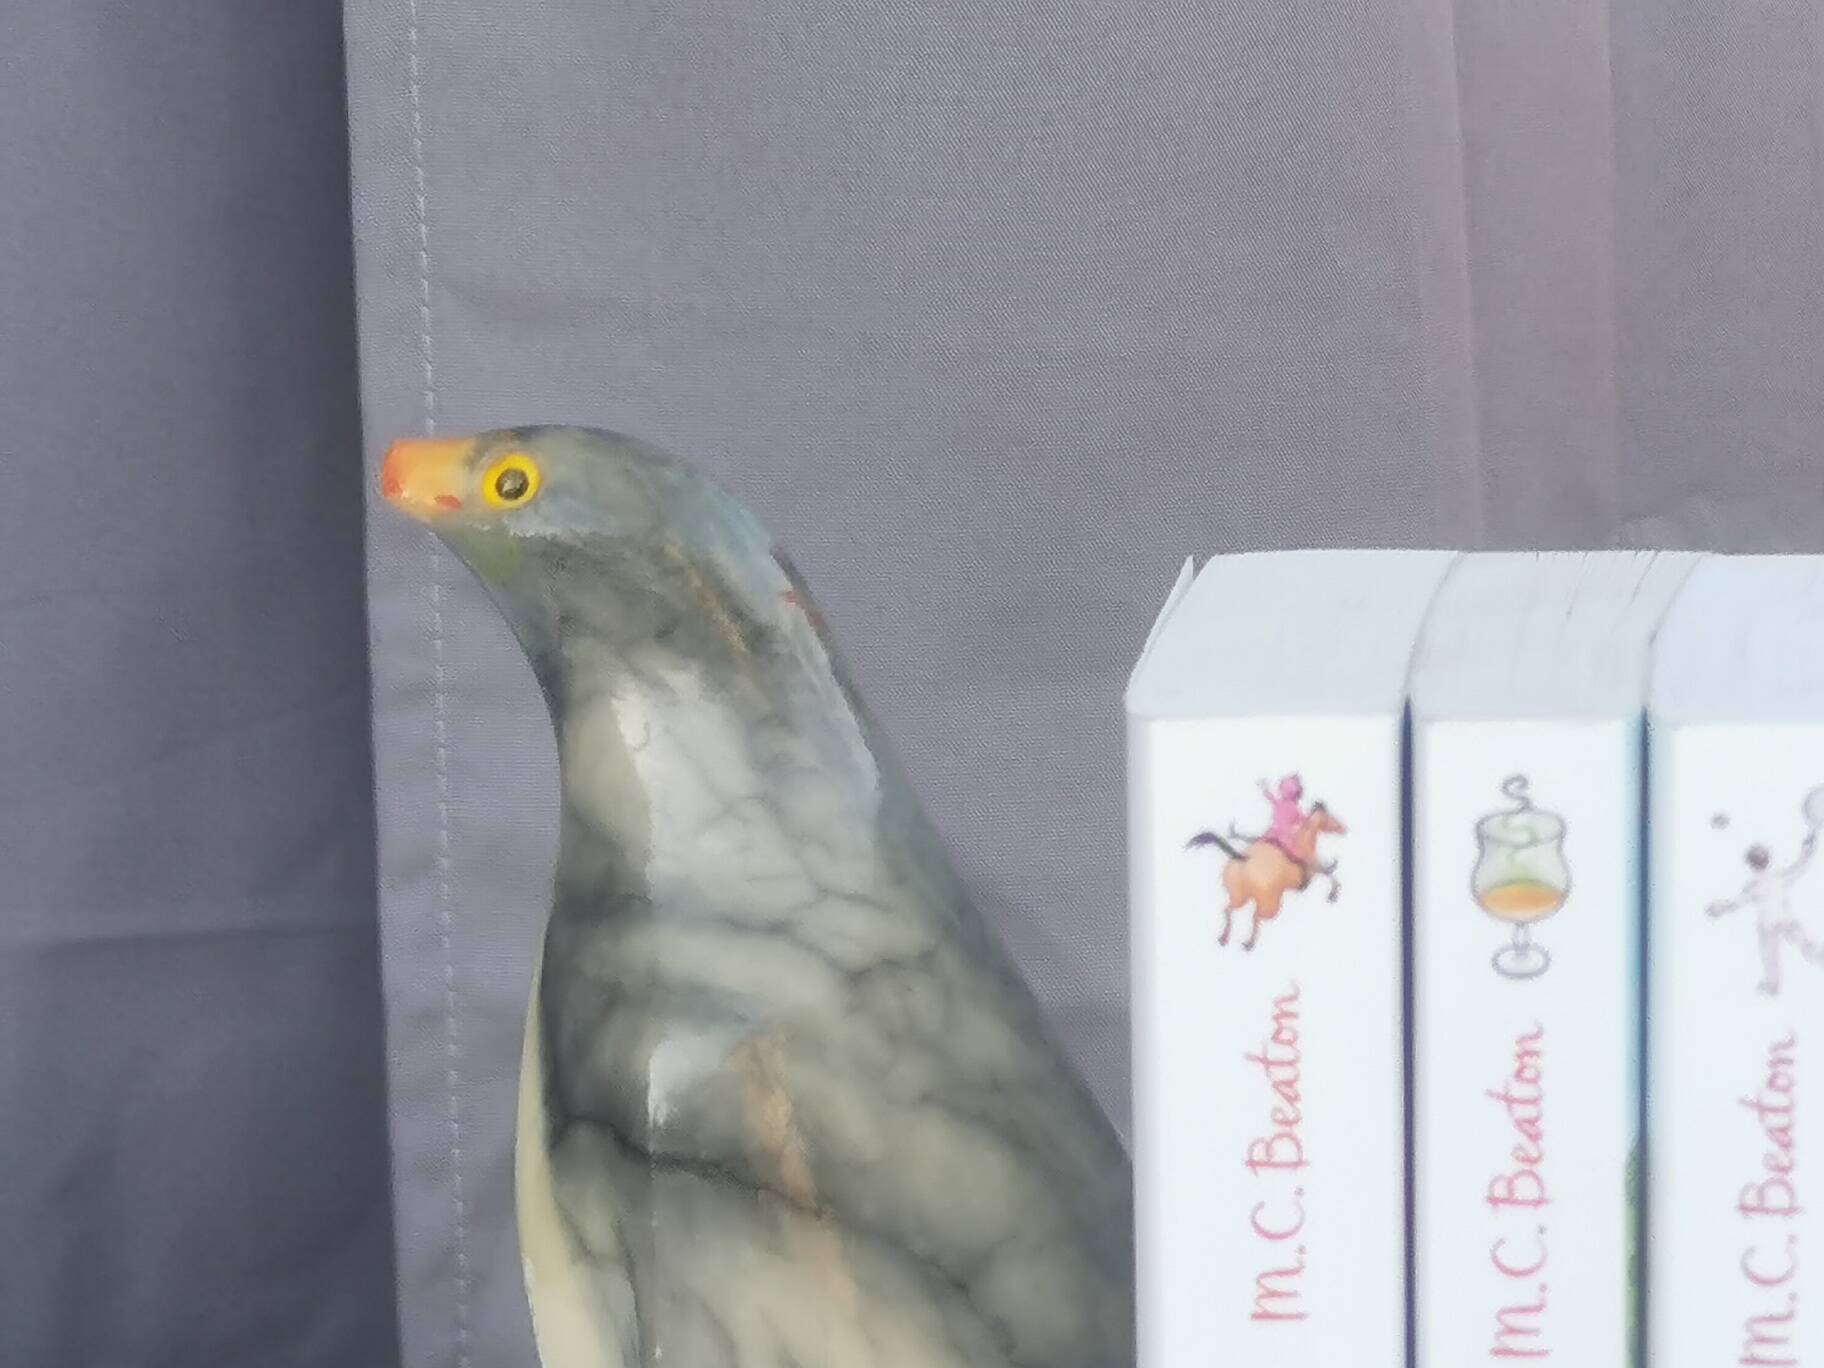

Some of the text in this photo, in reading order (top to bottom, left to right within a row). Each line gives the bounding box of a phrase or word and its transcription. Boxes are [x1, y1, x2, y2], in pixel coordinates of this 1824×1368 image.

[1242, 984, 1311, 1178] Beaton
[1483, 1025, 1552, 1211] Beaton
[1734, 1034, 1804, 1220] Beaton
